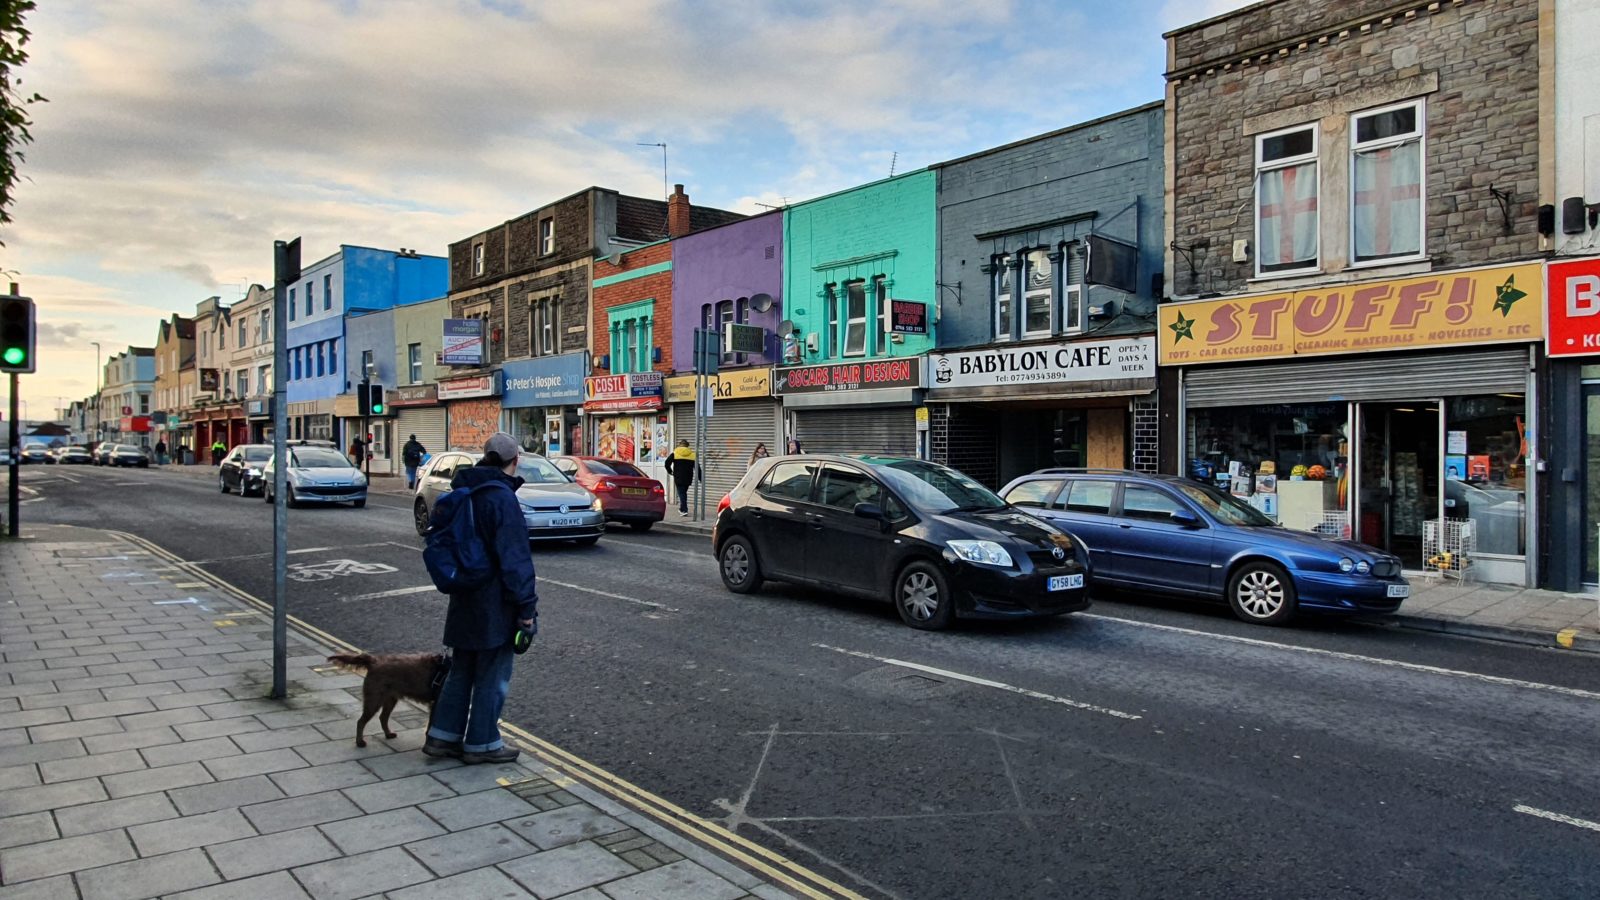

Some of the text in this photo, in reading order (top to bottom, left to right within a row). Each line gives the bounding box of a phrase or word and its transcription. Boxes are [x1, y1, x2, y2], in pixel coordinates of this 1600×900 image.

[894, 302, 923, 315] BARBER
[1206, 277, 1476, 346] STUFF!
[898, 313, 920, 325] SHOP
[453, 326, 479, 334] morgan
[1168, 324, 1531, 360] TOYS CAR ACCESSORIES CLEANING MATERIALS NOVELTIES ETC
[1118, 345, 1140, 353] OPEN
[959, 345, 1112, 375] BABYLON CAFE
[1118, 353, 1148, 363] DAYS A
[788, 360, 910, 388] OSCARS HAIR DESIGN
[1121, 364, 1144, 372] WEEK
[506, 379, 512, 391] St
[513, 376, 535, 390] Peter's
[535, 373, 562, 390] Hospice
[631, 373, 660, 382] COSTLESS
[1052, 575, 1082, 589] GY58 LHG
